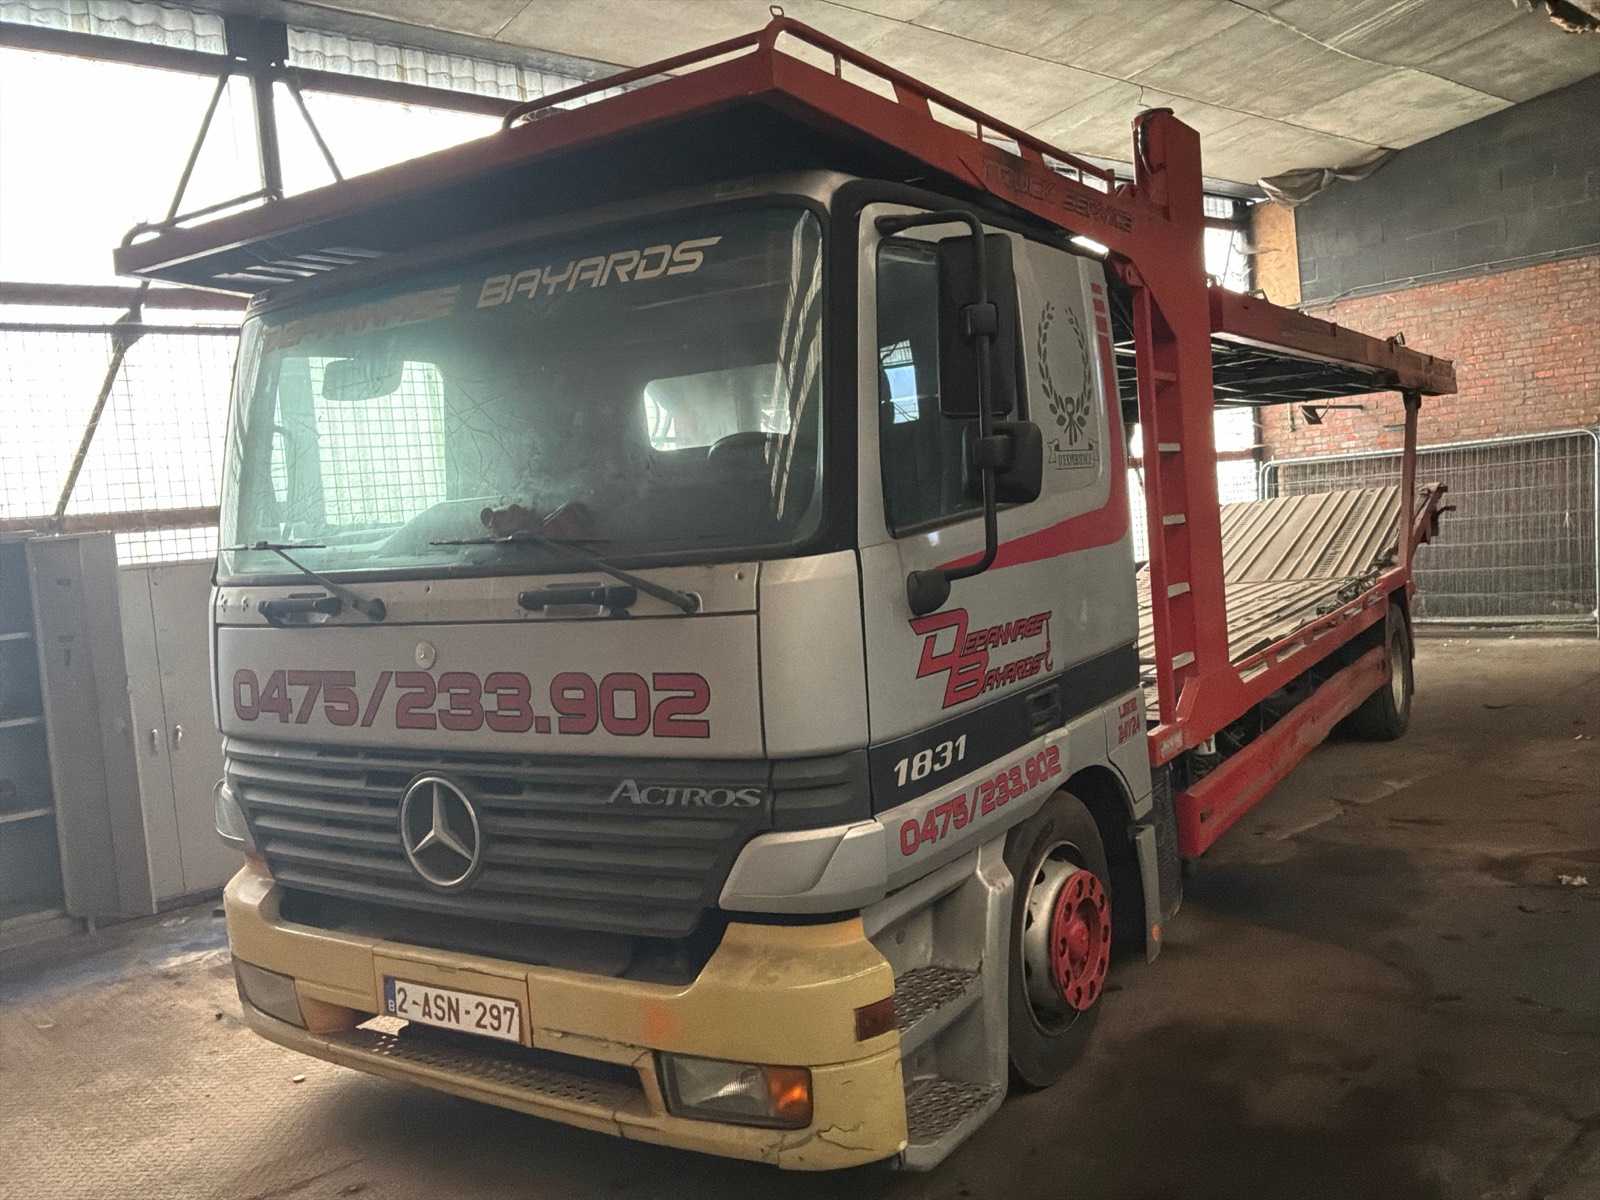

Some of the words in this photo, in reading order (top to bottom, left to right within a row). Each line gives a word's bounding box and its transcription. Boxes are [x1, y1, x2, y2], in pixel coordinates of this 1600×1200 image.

[476, 236, 722, 309] BAYARDS
[233, 668, 711, 739] 0475/233.902
[894, 734, 967, 787] 1831
[900, 745, 1062, 856] 0475/233.902
[397, 987, 516, 1034] 2-ASN-297
